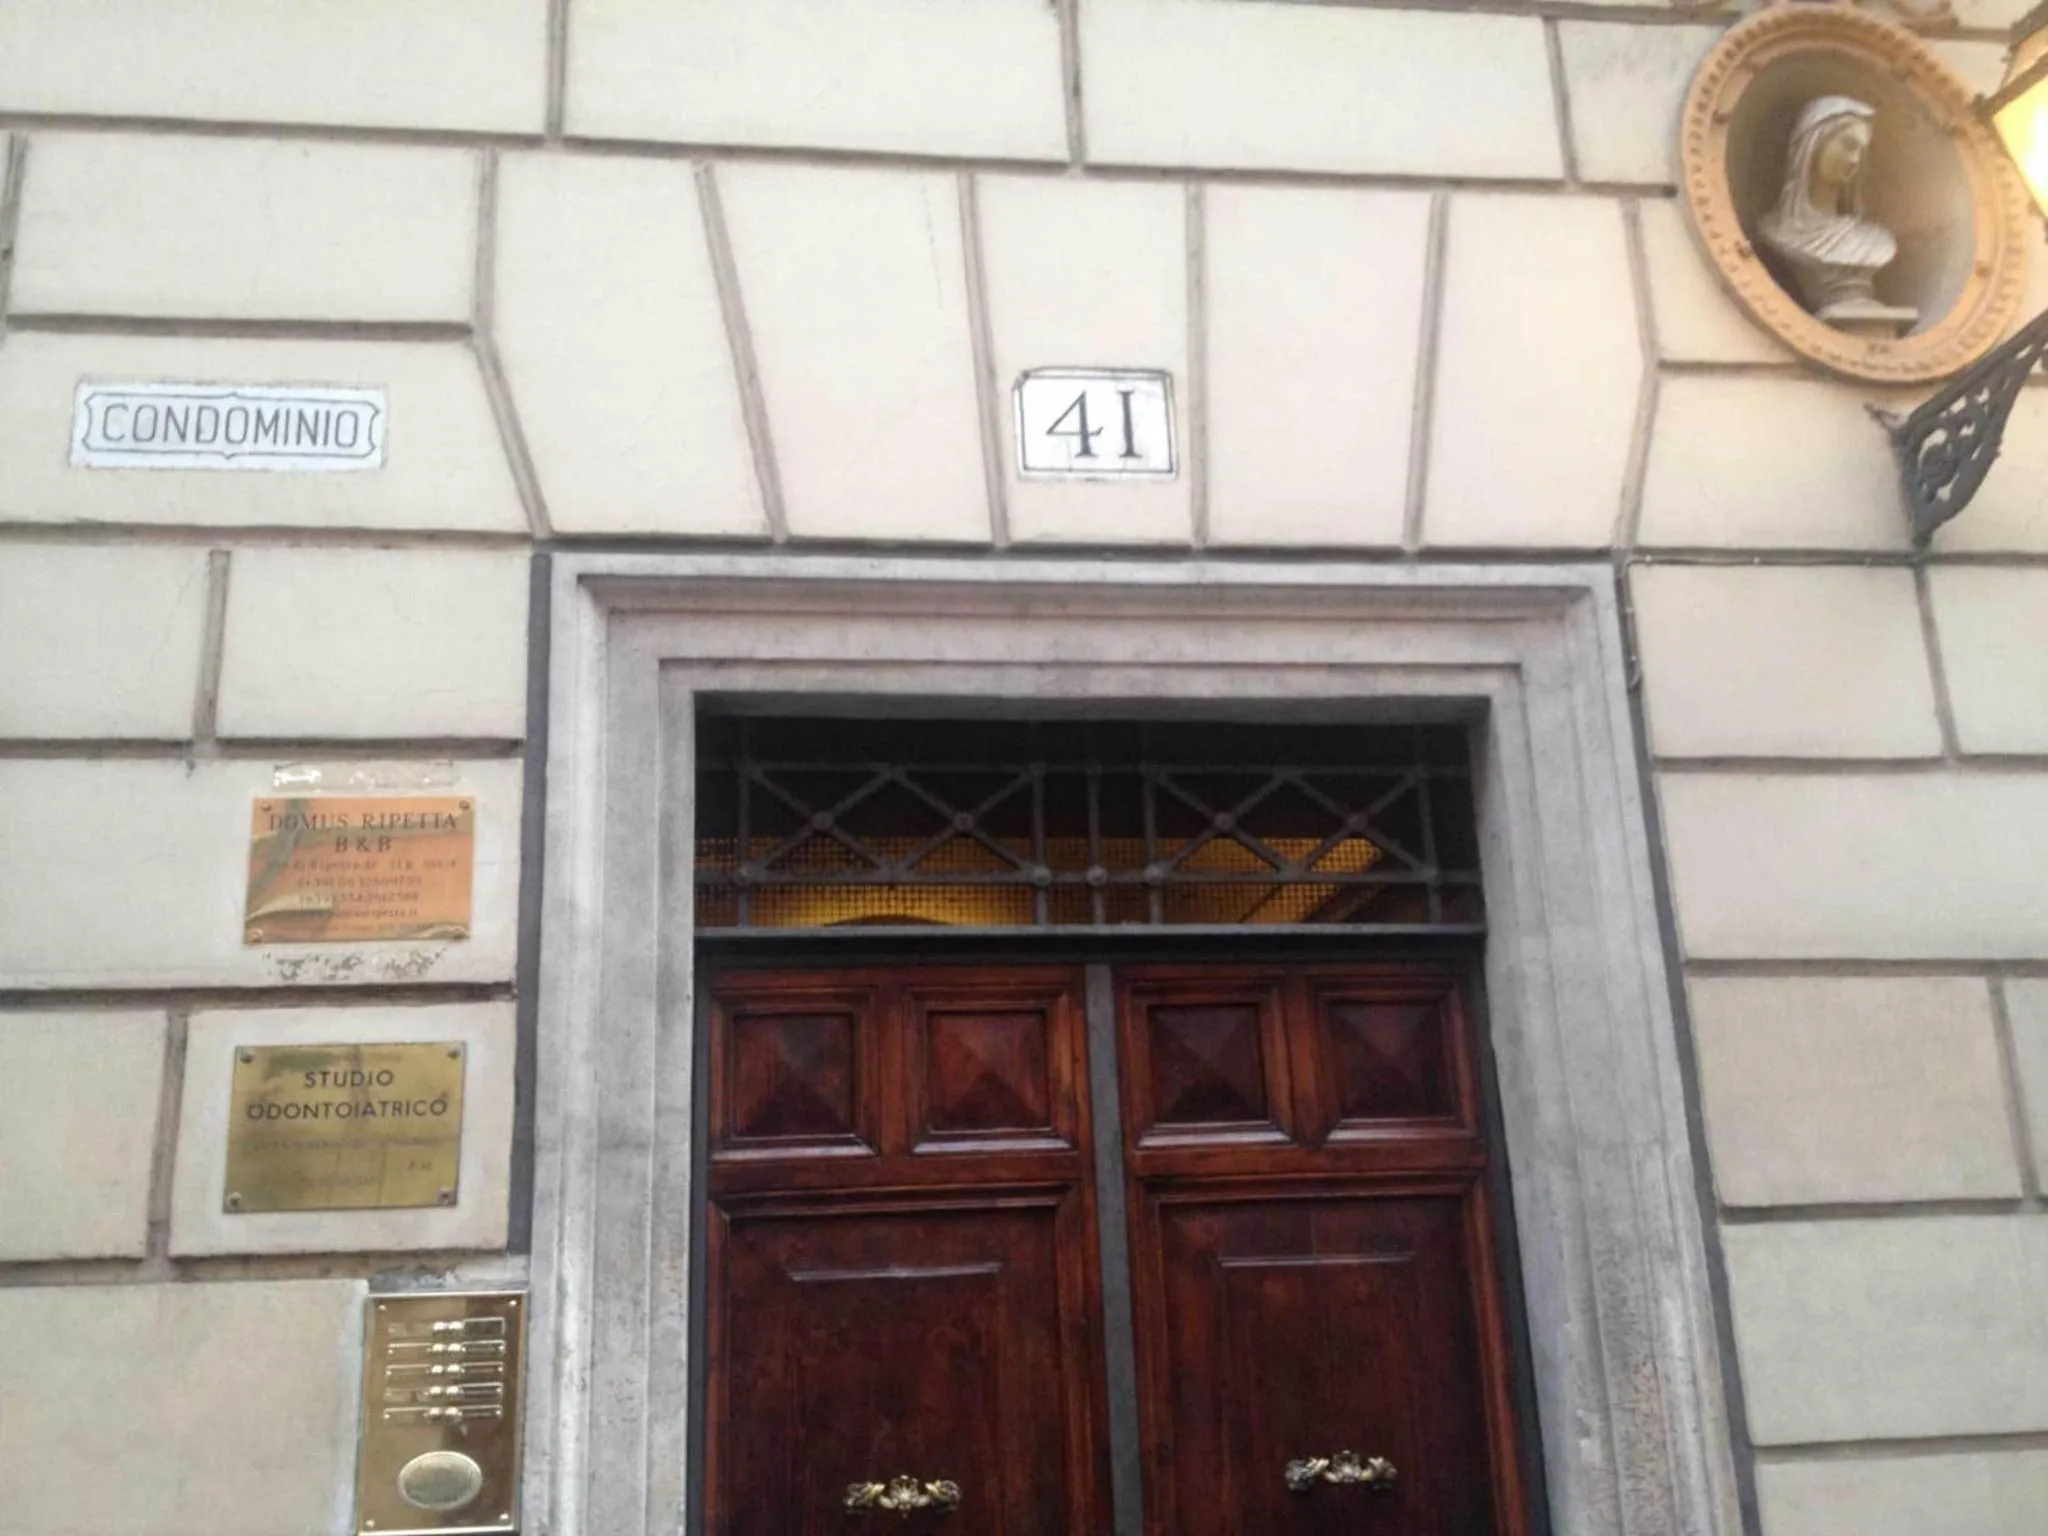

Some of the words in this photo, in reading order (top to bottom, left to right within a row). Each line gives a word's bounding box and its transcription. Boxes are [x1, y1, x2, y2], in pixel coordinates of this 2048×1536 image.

[101, 403, 360, 449] CONDOMINIO
[1045, 388, 1144, 459] 41
[268, 813, 349, 832] DOMUS
[361, 812, 457, 831] RIPETTA
[303, 1069, 395, 1089] STUDIO
[246, 1098, 448, 1121] ODONTOIATRICO
